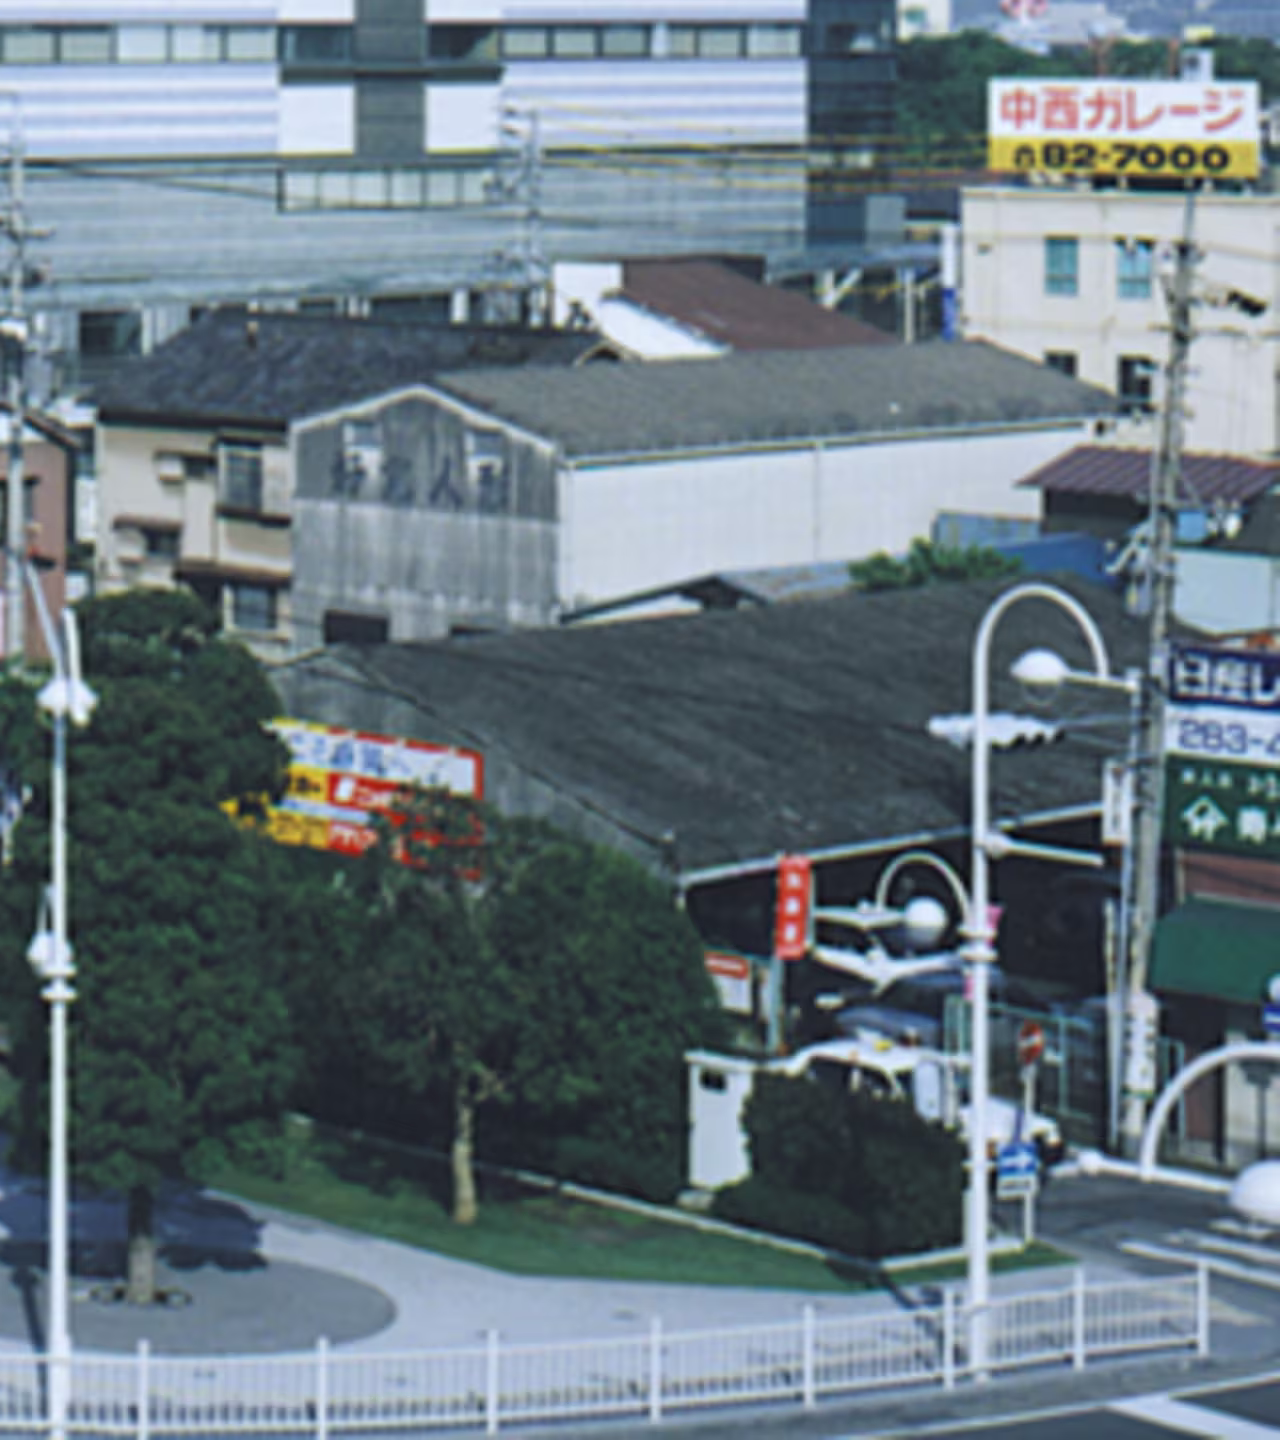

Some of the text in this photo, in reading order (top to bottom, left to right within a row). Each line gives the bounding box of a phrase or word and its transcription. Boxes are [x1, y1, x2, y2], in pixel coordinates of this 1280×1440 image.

[999, 86, 1246, 134] 中西ガレージ
